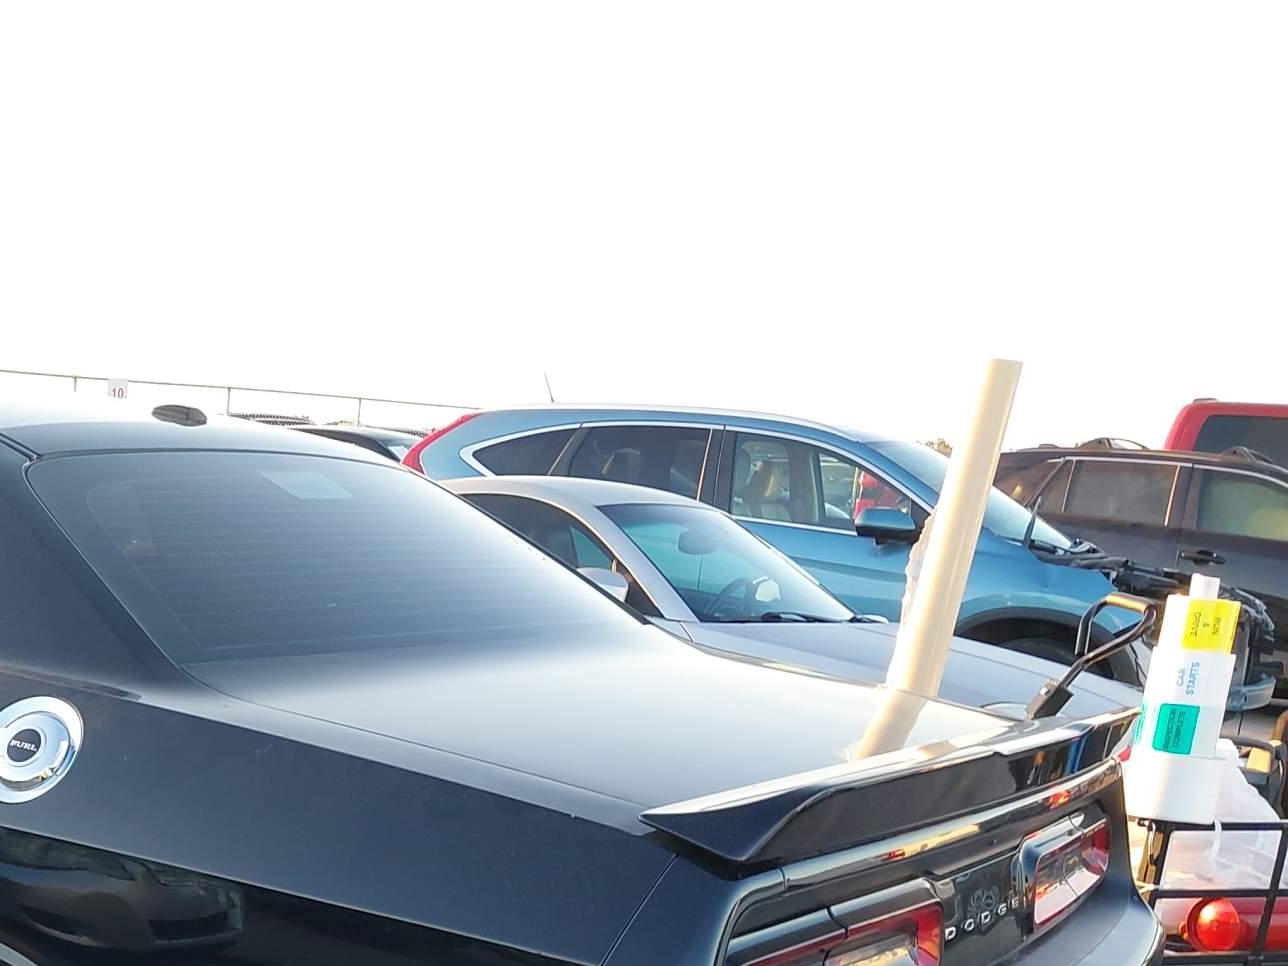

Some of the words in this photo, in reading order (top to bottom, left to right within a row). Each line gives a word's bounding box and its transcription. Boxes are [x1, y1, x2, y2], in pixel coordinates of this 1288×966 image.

[112, 387, 124, 399] 10
[1176, 668, 1186, 687] CAR
[1185, 661, 1200, 696] STARTS
[9, 739, 39, 752] FUEL
[944, 895, 1020, 941] DODGE
